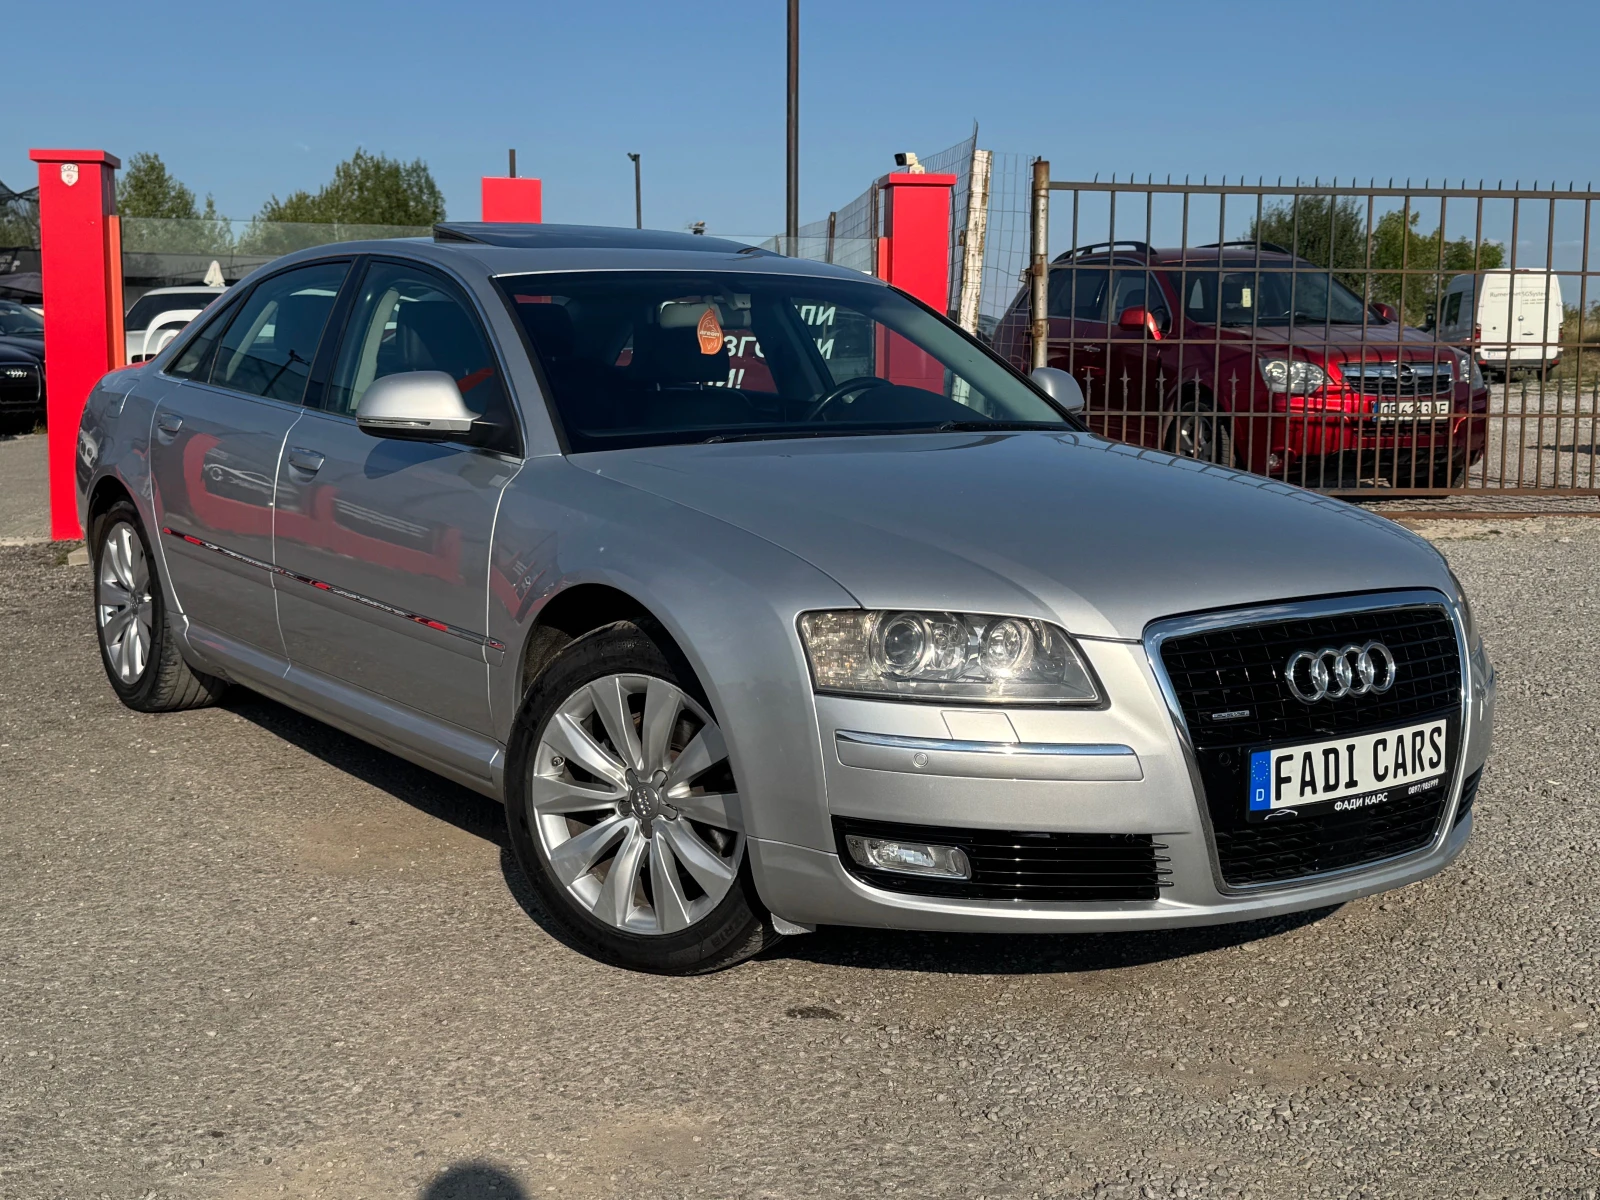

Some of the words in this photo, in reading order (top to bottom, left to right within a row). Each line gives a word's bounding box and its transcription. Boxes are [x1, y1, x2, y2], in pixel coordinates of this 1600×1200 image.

[1274, 744, 1359, 801] FADI
[1372, 726, 1443, 783] CARS
[1255, 788, 1265, 802] D
[1334, 797, 1363, 811] ФАДИ
[1365, 792, 1388, 806] КАРС
